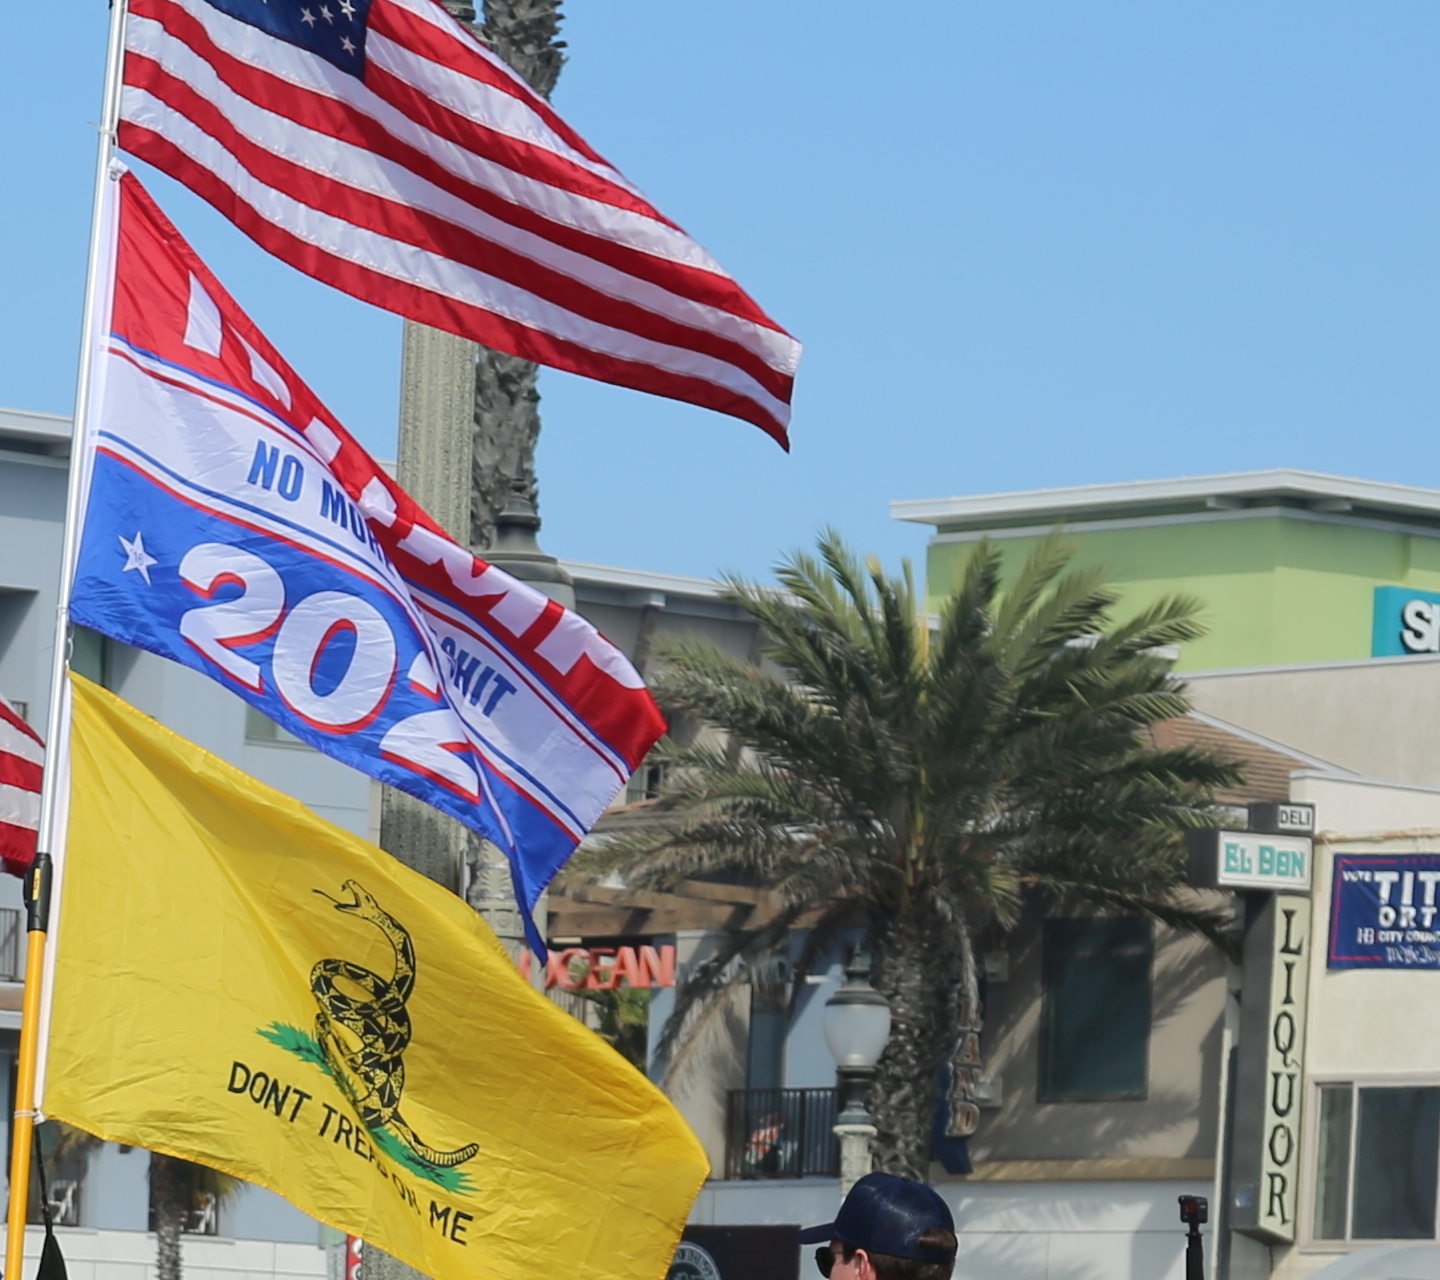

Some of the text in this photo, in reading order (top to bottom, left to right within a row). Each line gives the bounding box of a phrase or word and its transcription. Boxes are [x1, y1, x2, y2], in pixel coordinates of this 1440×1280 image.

[247, 439, 304, 502] NO
[178, 541, 482, 807] 202
[1278, 809, 1313, 827] DELI
[1224, 842, 1307, 879] EL BON
[1378, 930, 1405, 943] CITY
[1265, 908, 1304, 1227] LIQUOR
[429, 1200, 474, 1247] ME
